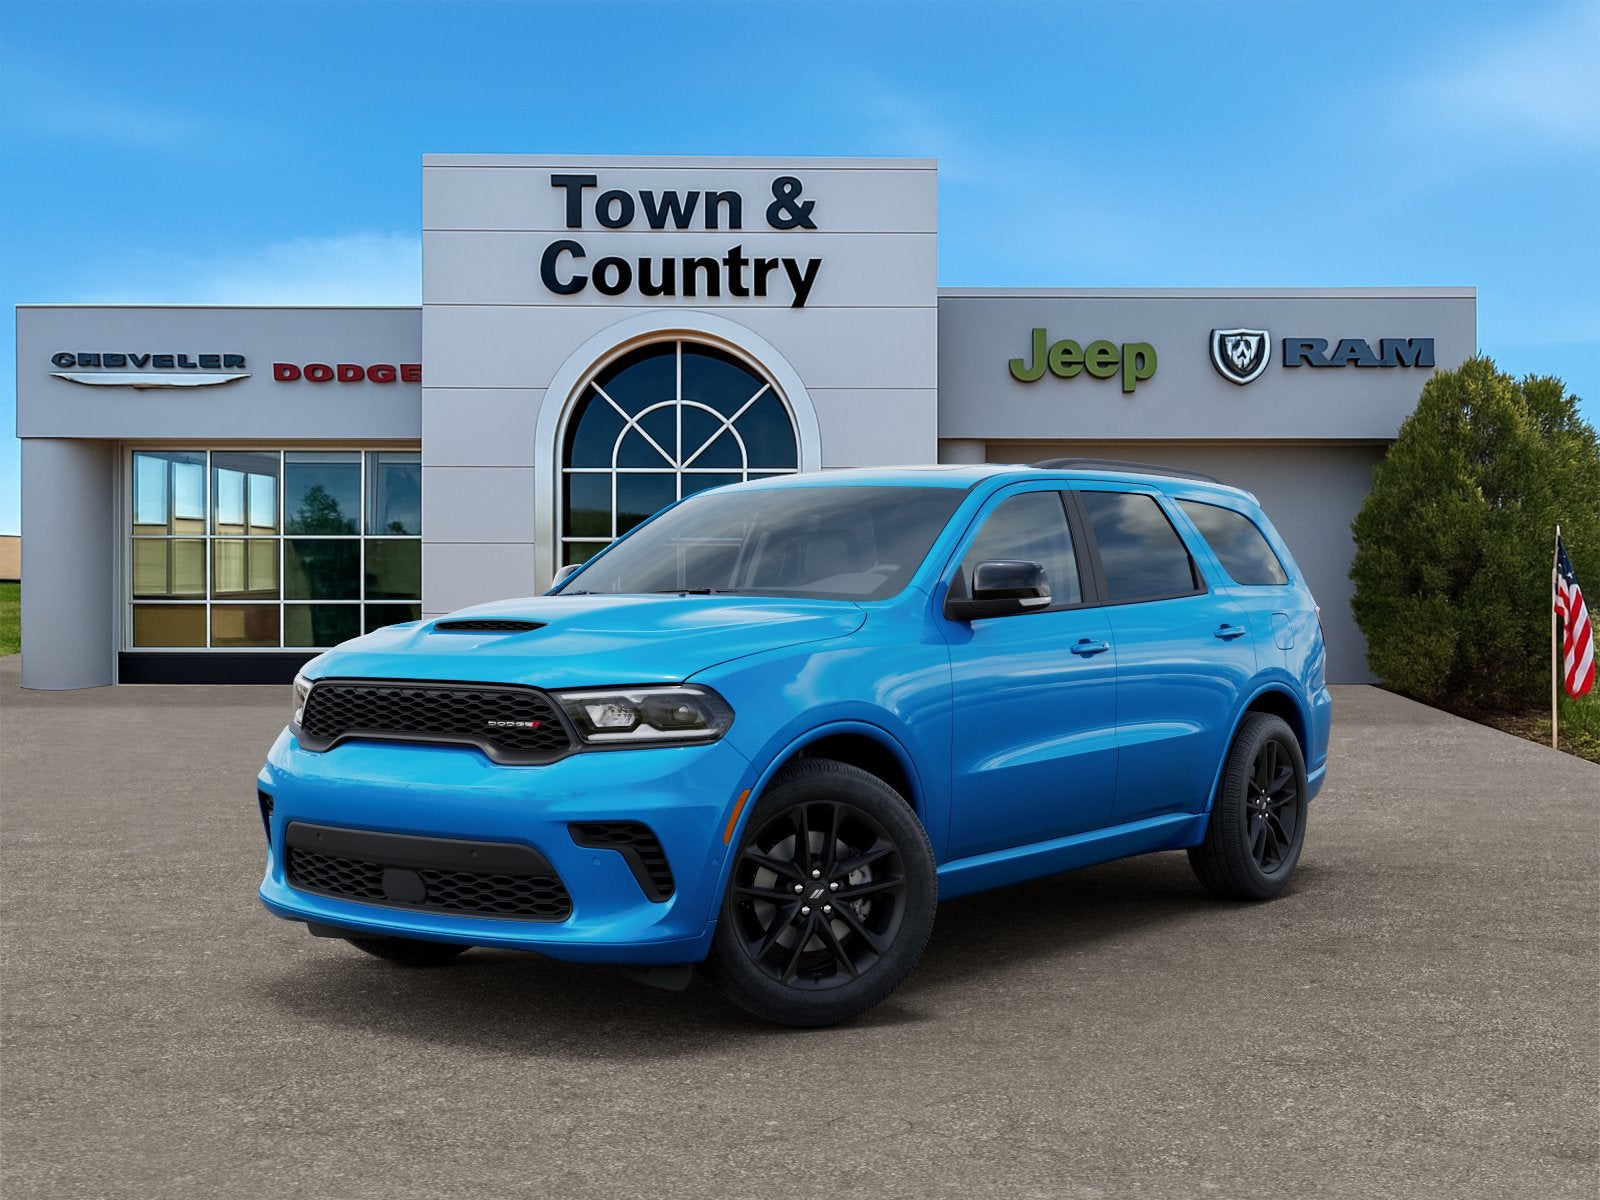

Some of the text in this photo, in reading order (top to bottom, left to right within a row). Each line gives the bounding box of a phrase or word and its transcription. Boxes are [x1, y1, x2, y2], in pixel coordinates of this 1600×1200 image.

[550, 174, 817, 230] Town &
[540, 239, 822, 308] Country
[273, 363, 422, 383] DODGE
[1009, 328, 1157, 393] Jeep
[1283, 338, 1435, 367] RAM
